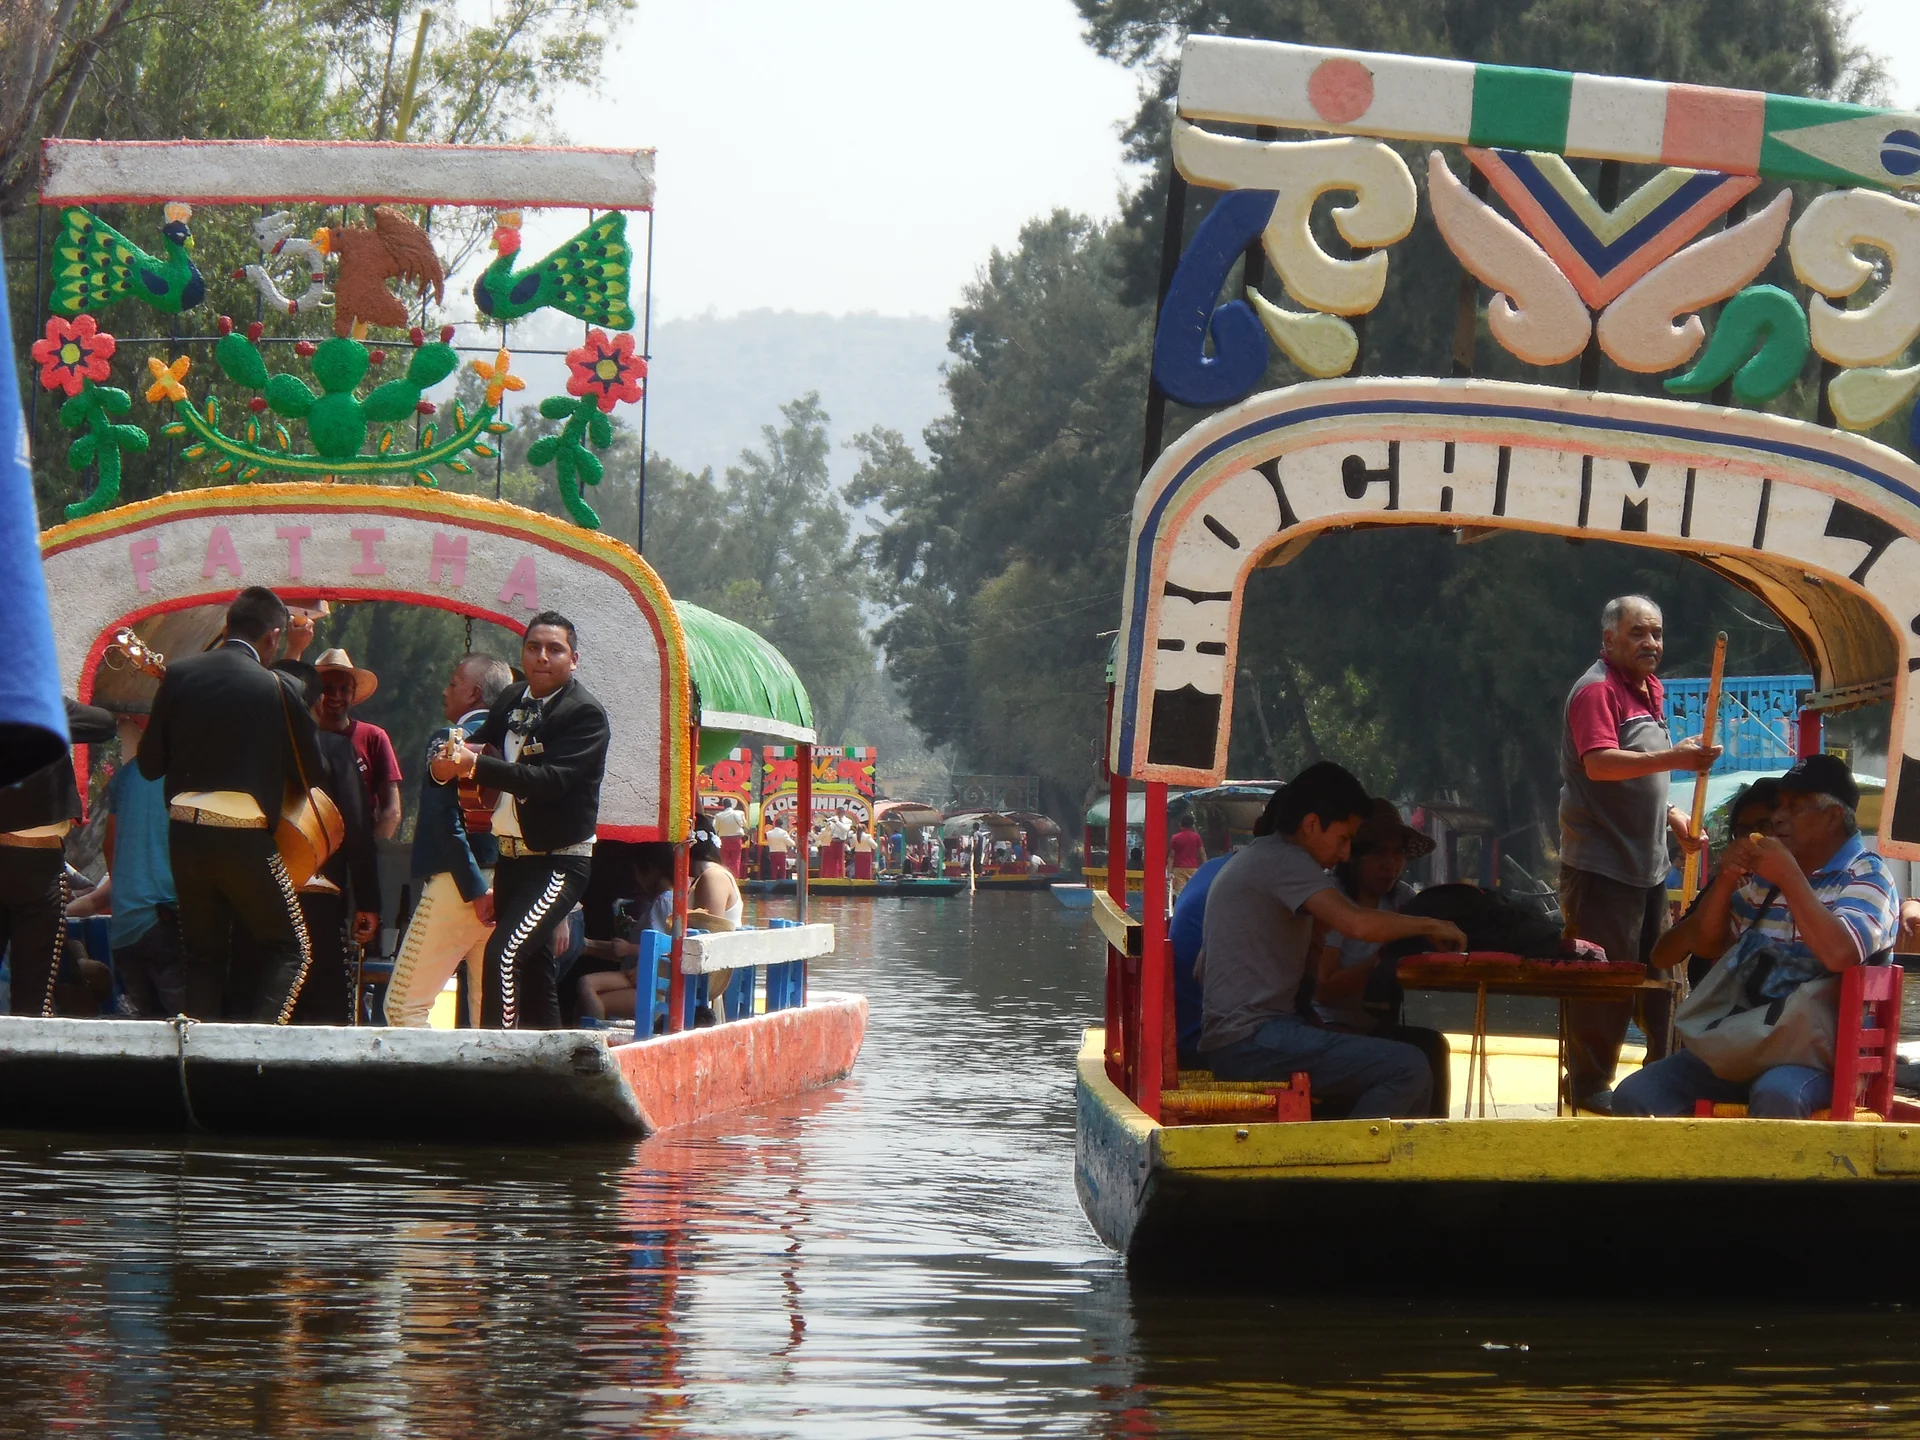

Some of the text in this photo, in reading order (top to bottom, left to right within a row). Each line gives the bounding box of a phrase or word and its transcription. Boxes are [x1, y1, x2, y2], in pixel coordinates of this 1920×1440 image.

[129, 525, 538, 610] FATIMA
[1152, 437, 1920, 758] XOCHIMIL
[764, 796, 869, 822] XOCIMILCO
